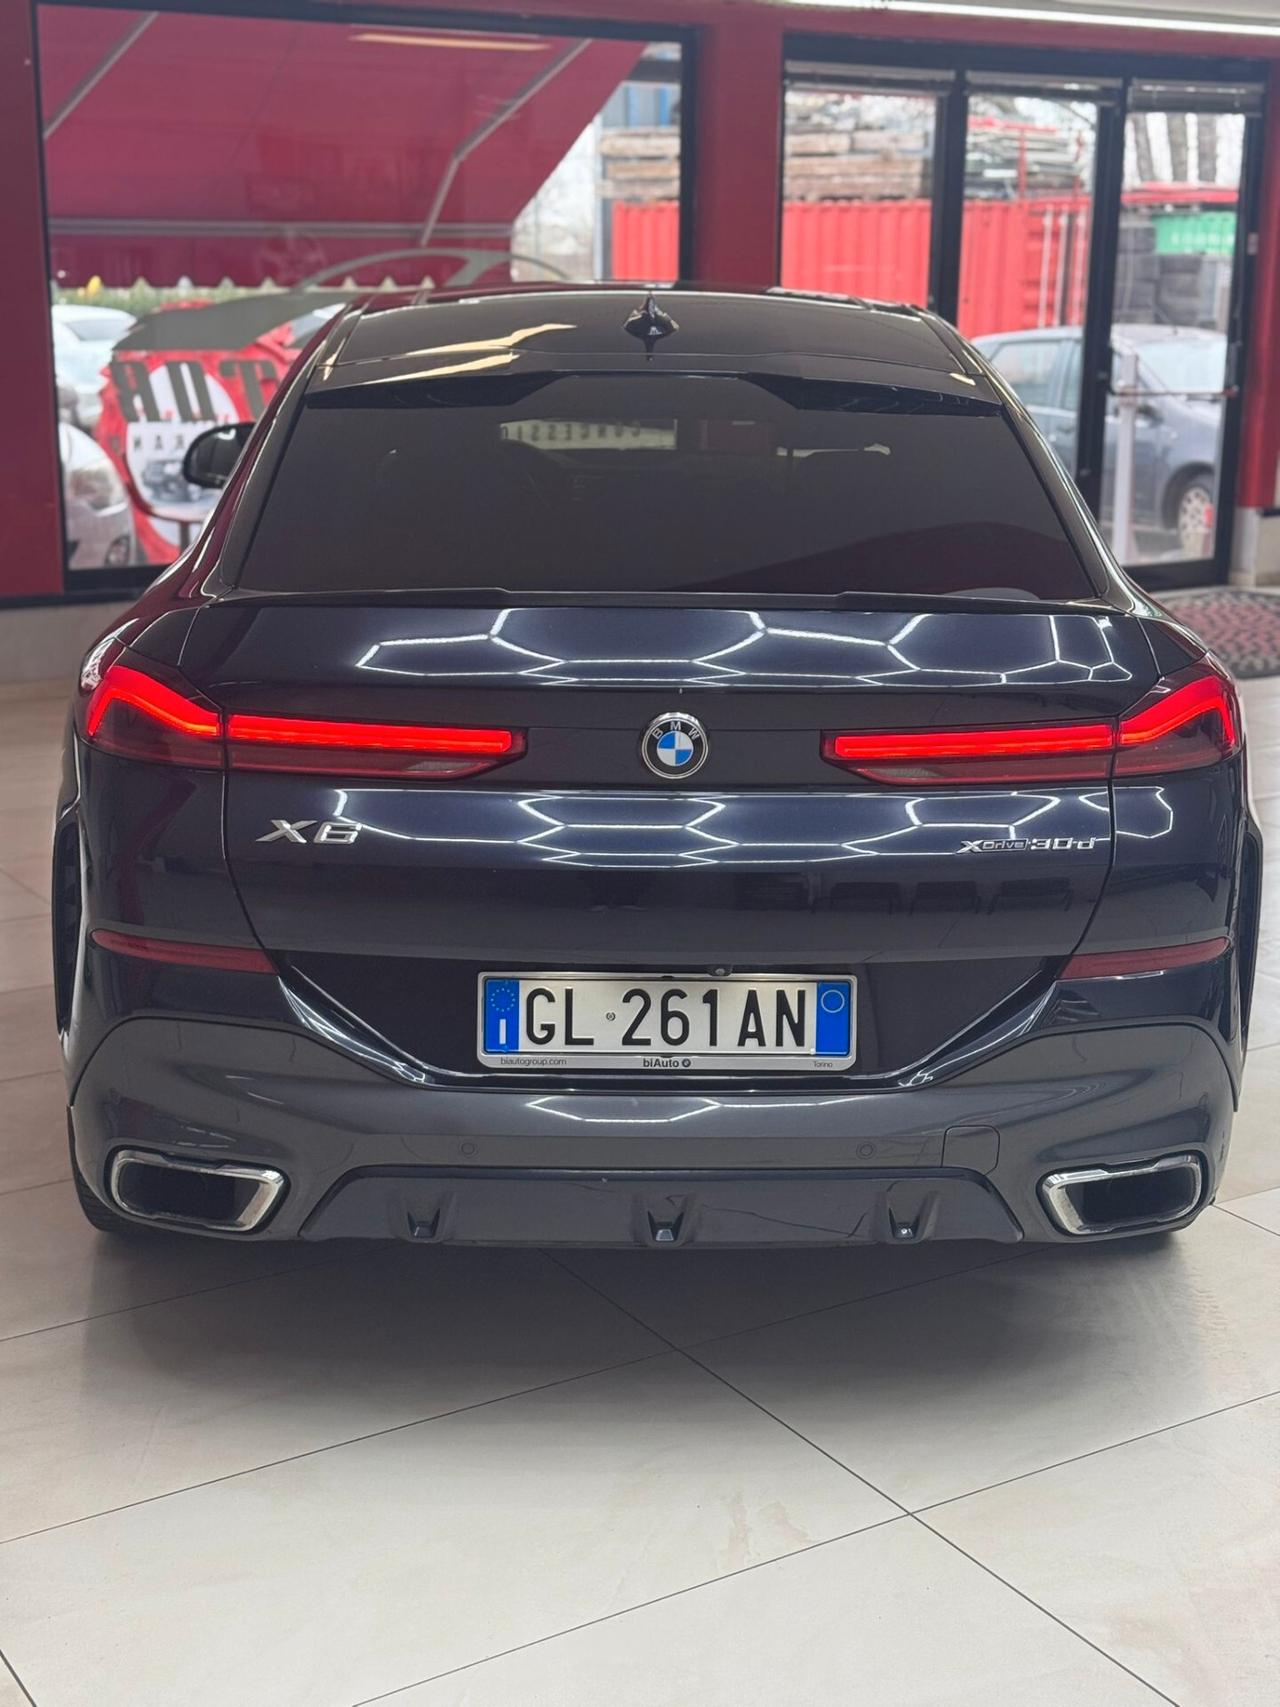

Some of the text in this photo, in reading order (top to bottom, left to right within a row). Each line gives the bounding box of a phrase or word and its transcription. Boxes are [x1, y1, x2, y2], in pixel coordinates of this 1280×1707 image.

[651, 721, 701, 740] BMW
[255, 819, 362, 844] X6
[525, 987, 595, 1047] GL
[500, 1056, 567, 1067] biautogroup.com
[642, 1057, 680, 1068] biAuto
